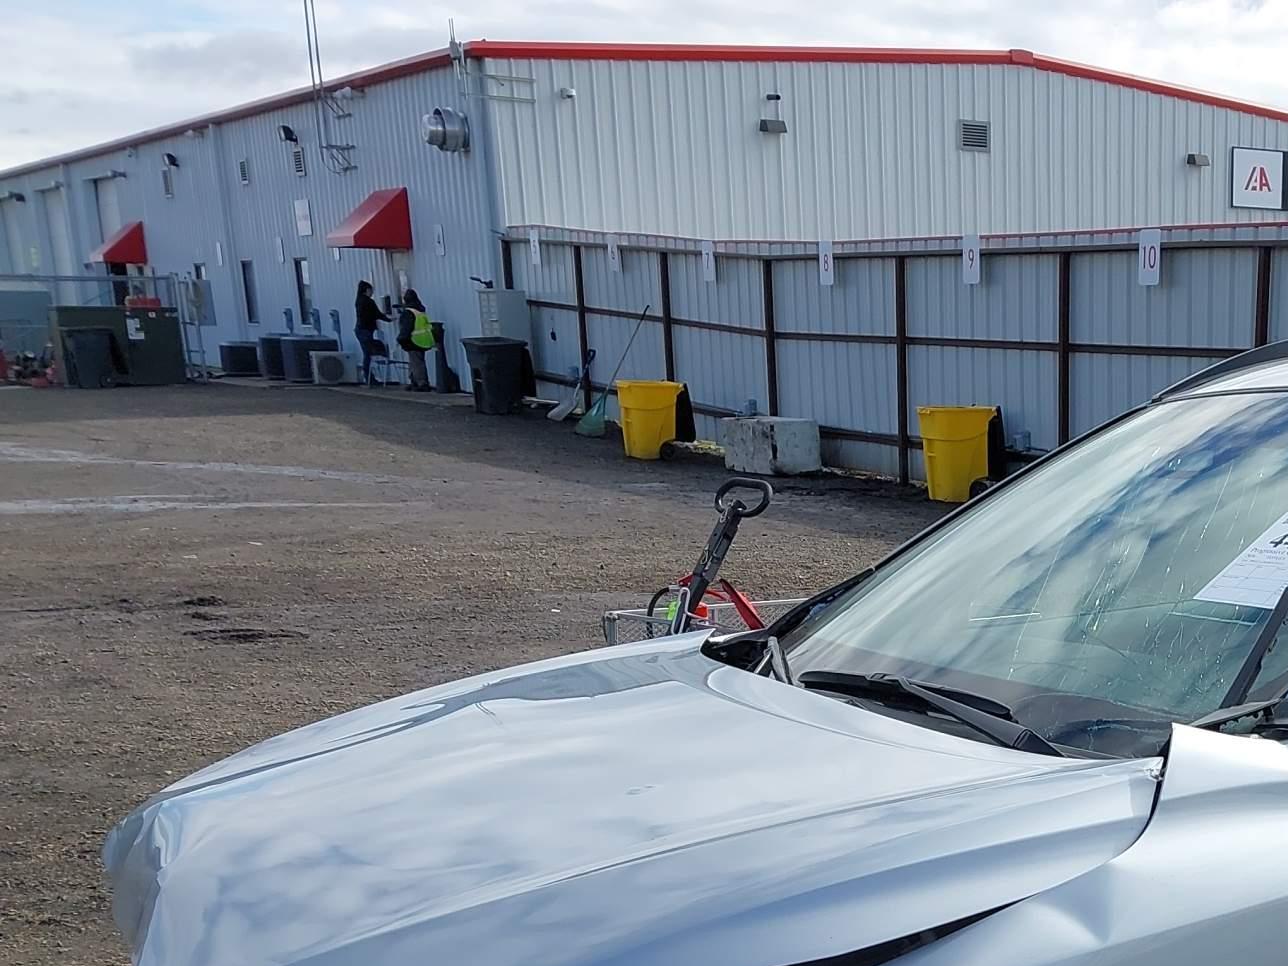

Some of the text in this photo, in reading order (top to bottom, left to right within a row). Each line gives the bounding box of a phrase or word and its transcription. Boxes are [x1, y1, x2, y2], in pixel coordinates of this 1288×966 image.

[823, 253, 829, 272] 8
[967, 249, 975, 270] 9
[1141, 245, 1157, 269] 10
